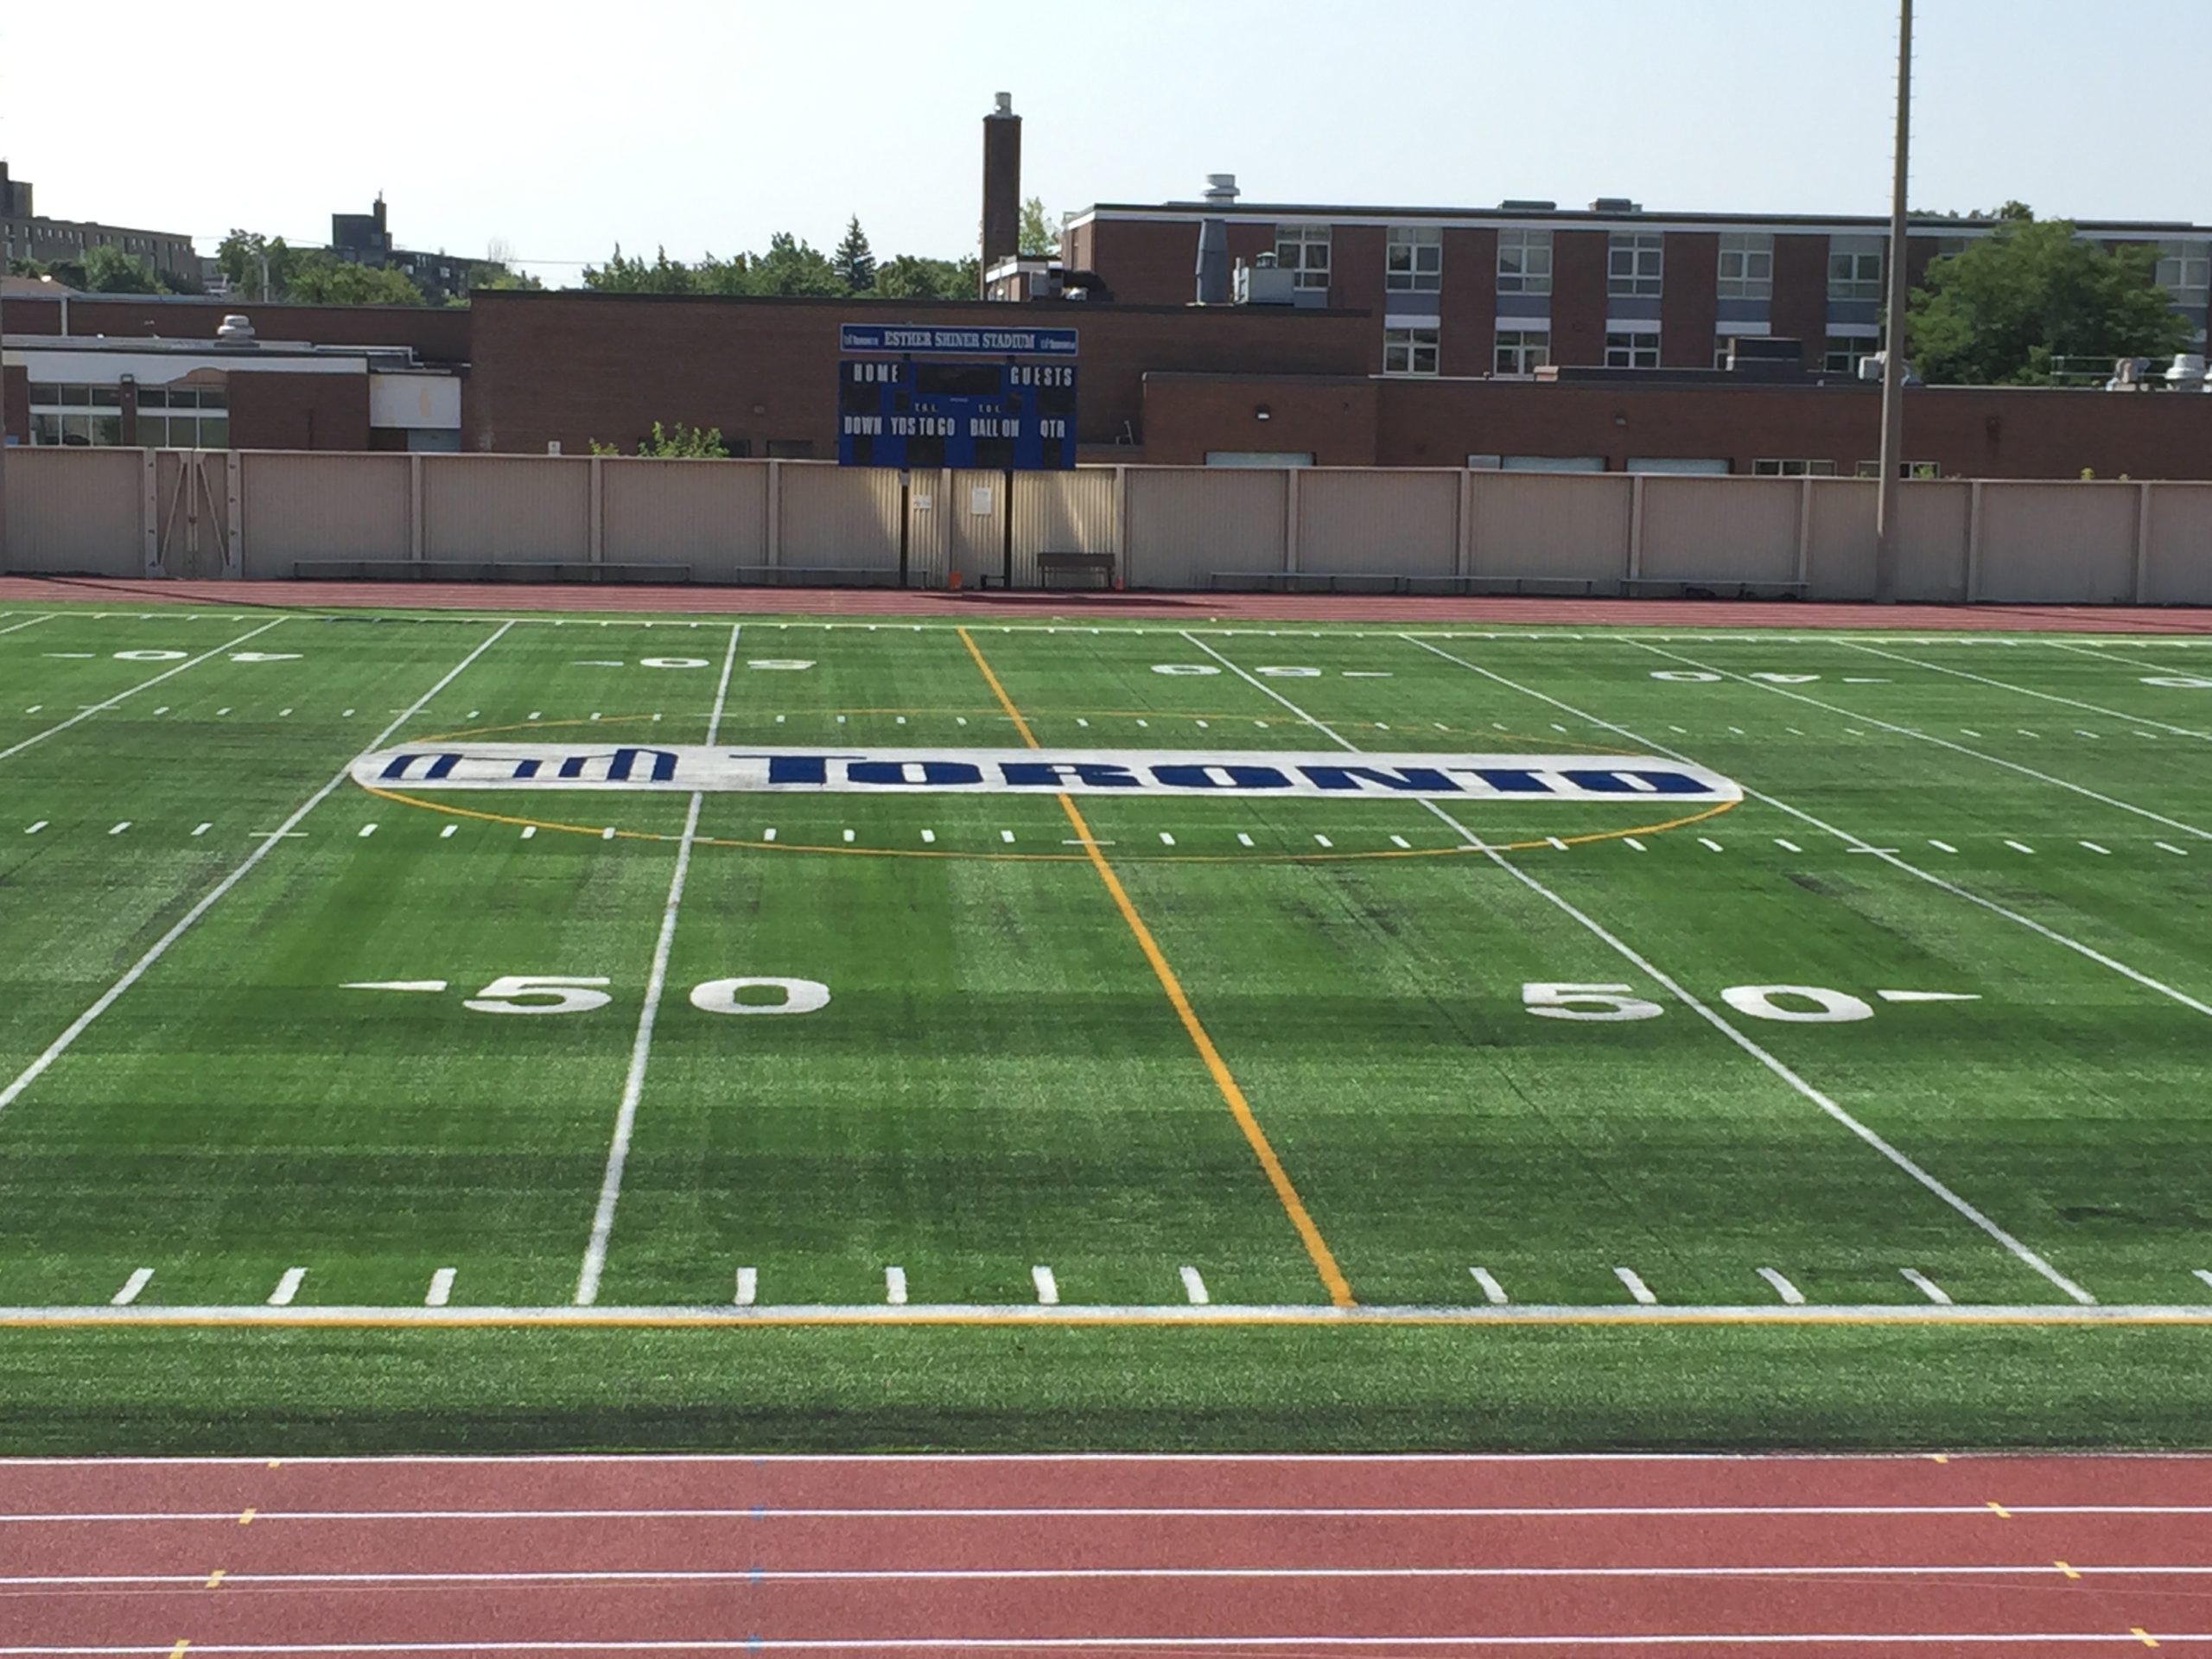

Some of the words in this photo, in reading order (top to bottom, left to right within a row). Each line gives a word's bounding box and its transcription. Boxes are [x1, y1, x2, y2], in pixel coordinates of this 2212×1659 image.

[884, 331, 932, 346] ESTHER
[935, 333, 980, 348] SHINER
[982, 333, 1035, 349] STADIUM
[854, 363, 899, 383] HOME
[1011, 367, 1072, 386] GUESTS
[844, 416, 882, 435] DOWN
[891, 416, 917, 435] YDS
[919, 417, 936, 435] TO
[938, 417, 956, 436] GO
[970, 418, 999, 437] BALL
[1001, 419, 1020, 437] ON
[1040, 420, 1065, 438] QTR
[729, 753, 1717, 794] TORONTO
